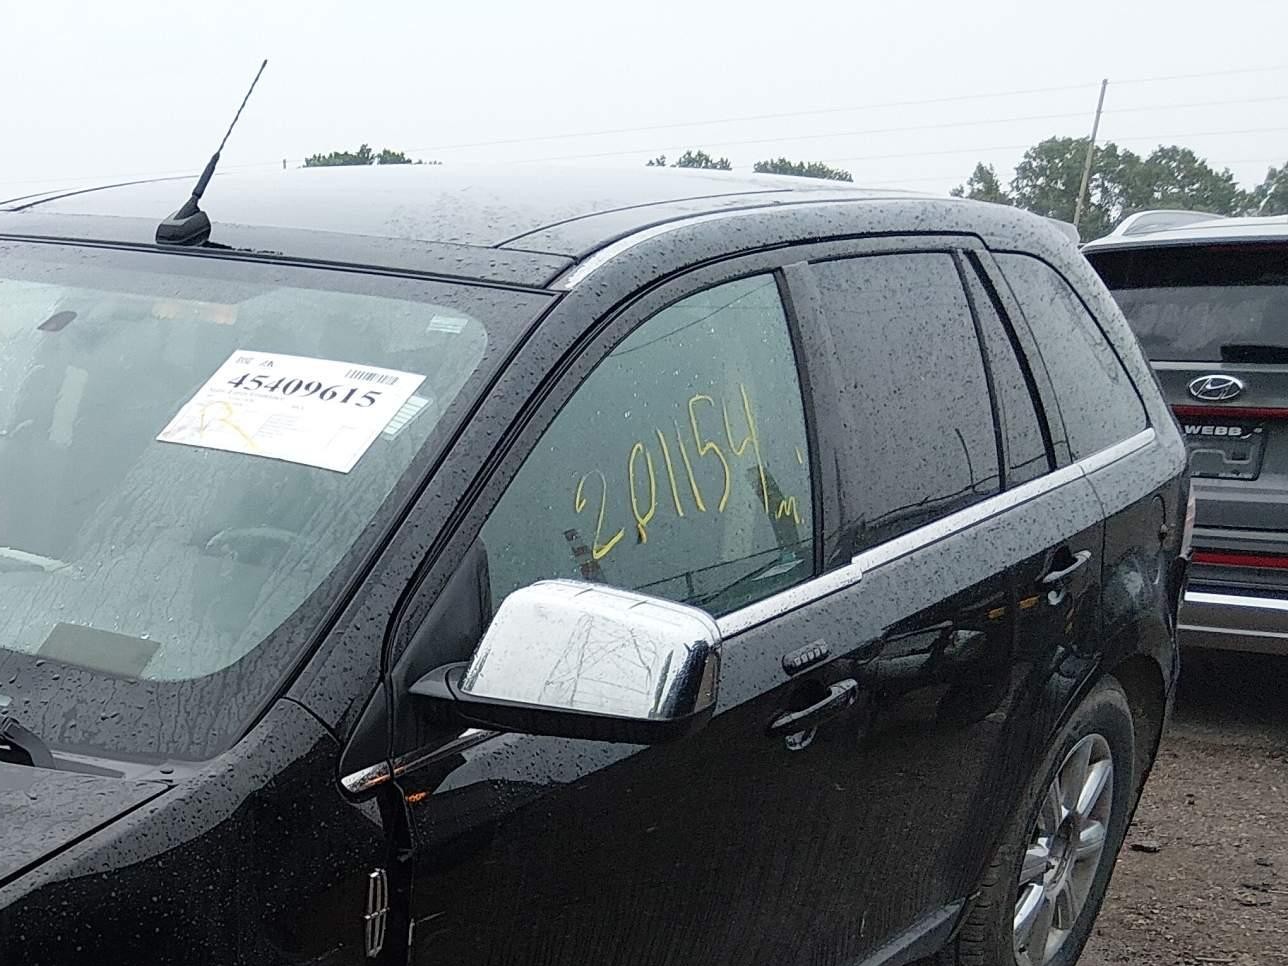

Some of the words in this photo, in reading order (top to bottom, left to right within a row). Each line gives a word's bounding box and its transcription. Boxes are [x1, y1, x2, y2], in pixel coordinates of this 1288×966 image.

[227, 371, 384, 408] 45409615
[1183, 424, 1242, 436] WEBB
[575, 382, 769, 560] 201154
